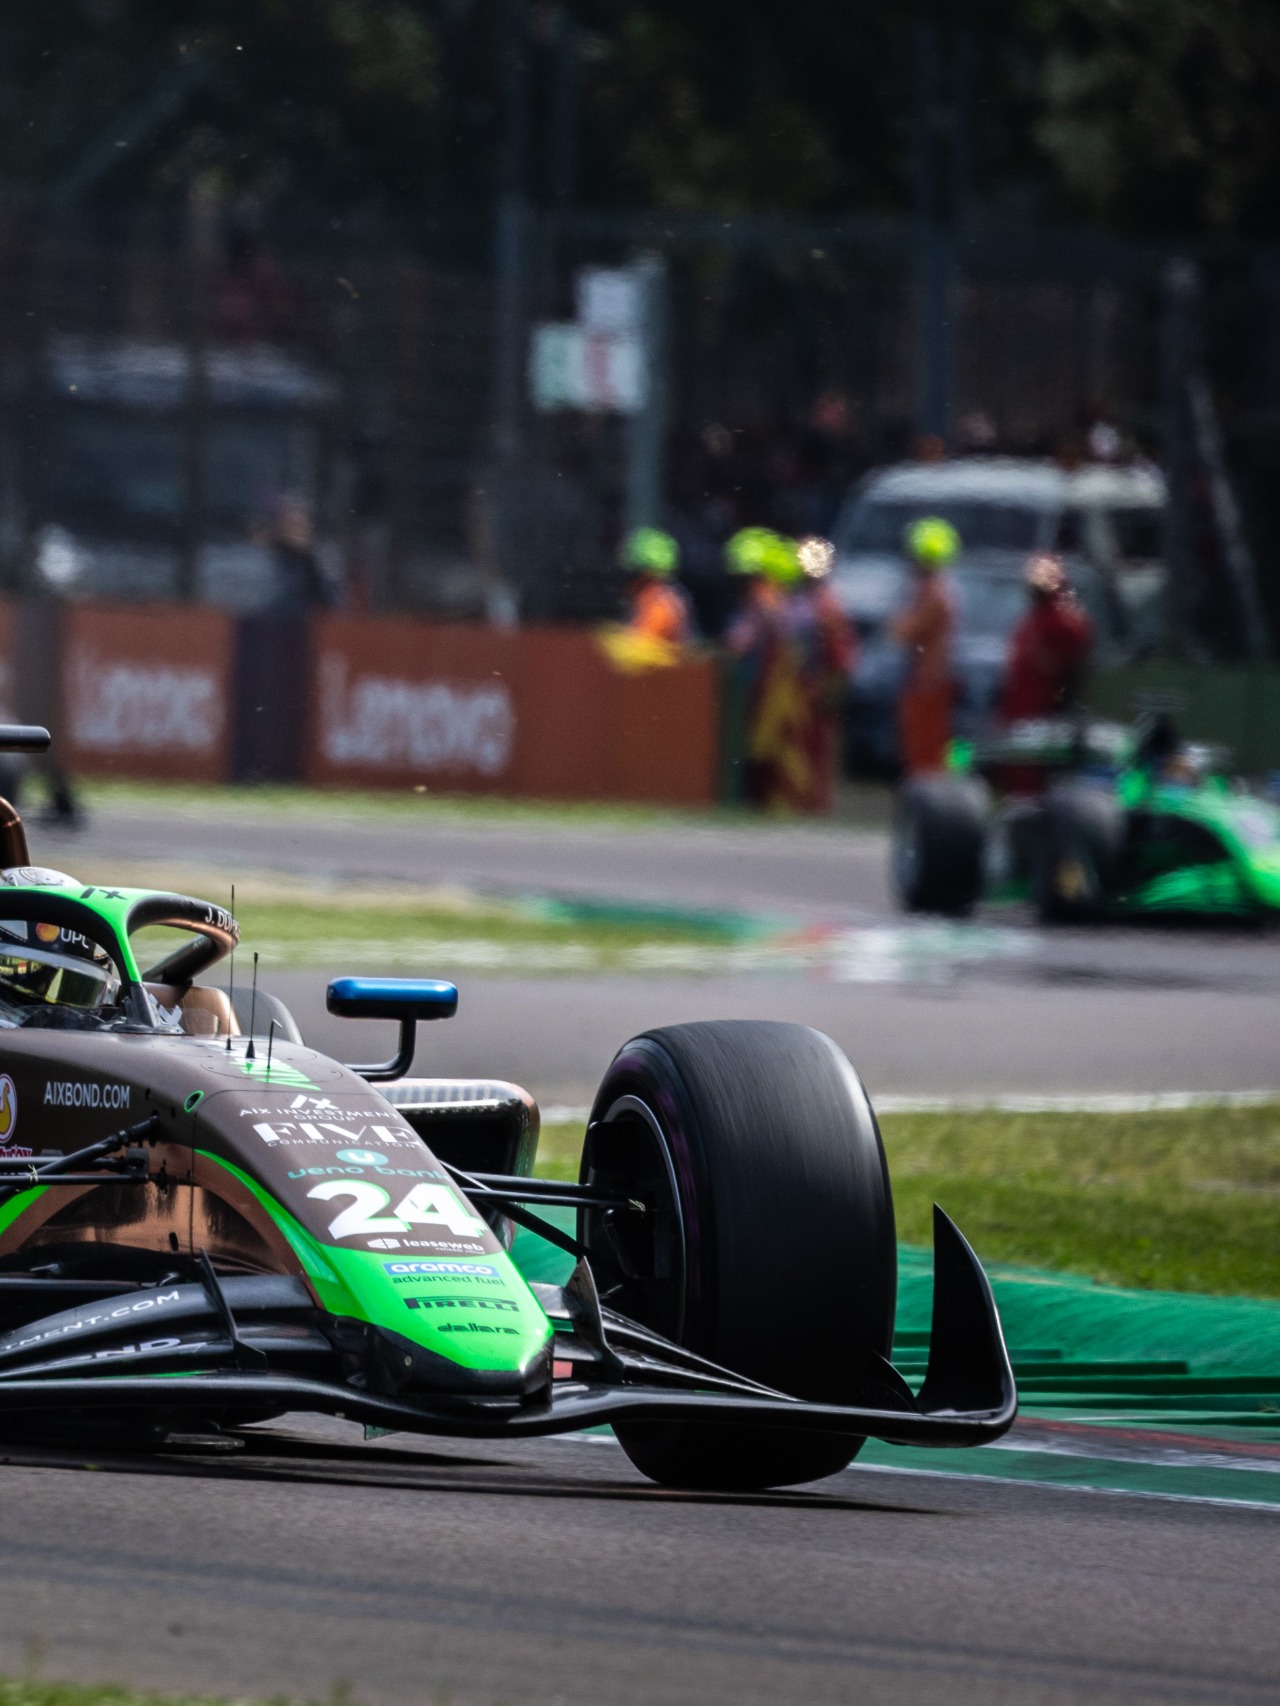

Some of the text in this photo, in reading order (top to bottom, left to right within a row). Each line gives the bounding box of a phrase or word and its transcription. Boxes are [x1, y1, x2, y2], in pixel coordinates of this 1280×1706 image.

[60, 927, 89, 949] UPL
[43, 1081, 132, 1109] AIXBOND.COM
[240, 1108, 398, 1120] AIX INVESTMENT
[294, 1114, 356, 1122] GROUP
[306, 1179, 489, 1240] 24
[402, 1238, 484, 1251] leaseweb
[391, 1263, 494, 1275] aramco
[393, 1274, 506, 1287] advanced fuel
[403, 1296, 521, 1312] PIRELLI
[438, 1322, 520, 1336] dallara
